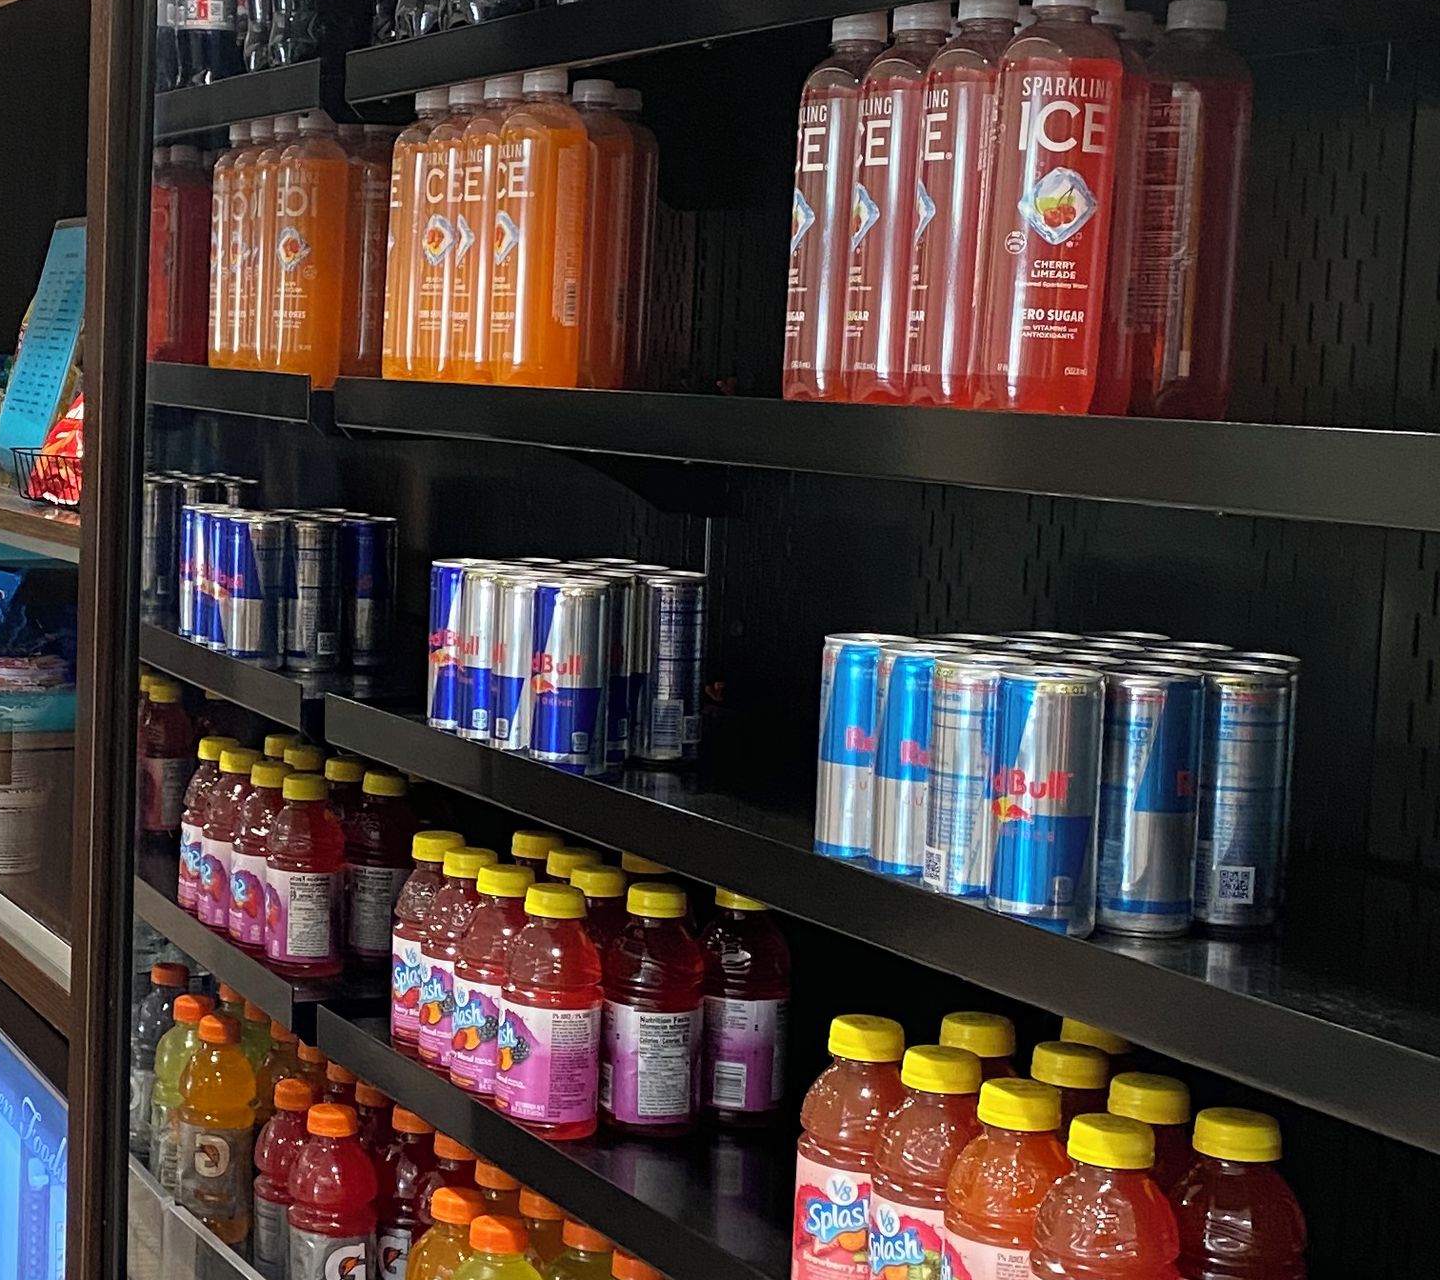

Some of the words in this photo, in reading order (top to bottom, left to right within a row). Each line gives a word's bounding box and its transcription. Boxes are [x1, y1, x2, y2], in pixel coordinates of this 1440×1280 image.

[1018, 100, 1110, 153] ICE
[1031, 270, 1076, 280] LIMEADE
[1034, 260, 1076, 270] CHERRY
[1022, 308, 1044, 321] ERO
[1047, 308, 1085, 322] SUGAR
[1033, 324, 1067, 332] VITAMINS
[846, 727, 875, 753] Re
[900, 741, 931, 767] Re
[1009, 769, 1073, 801] Bull
[832, 1178, 851, 1202] V8
[879, 1209, 896, 1232] V8
